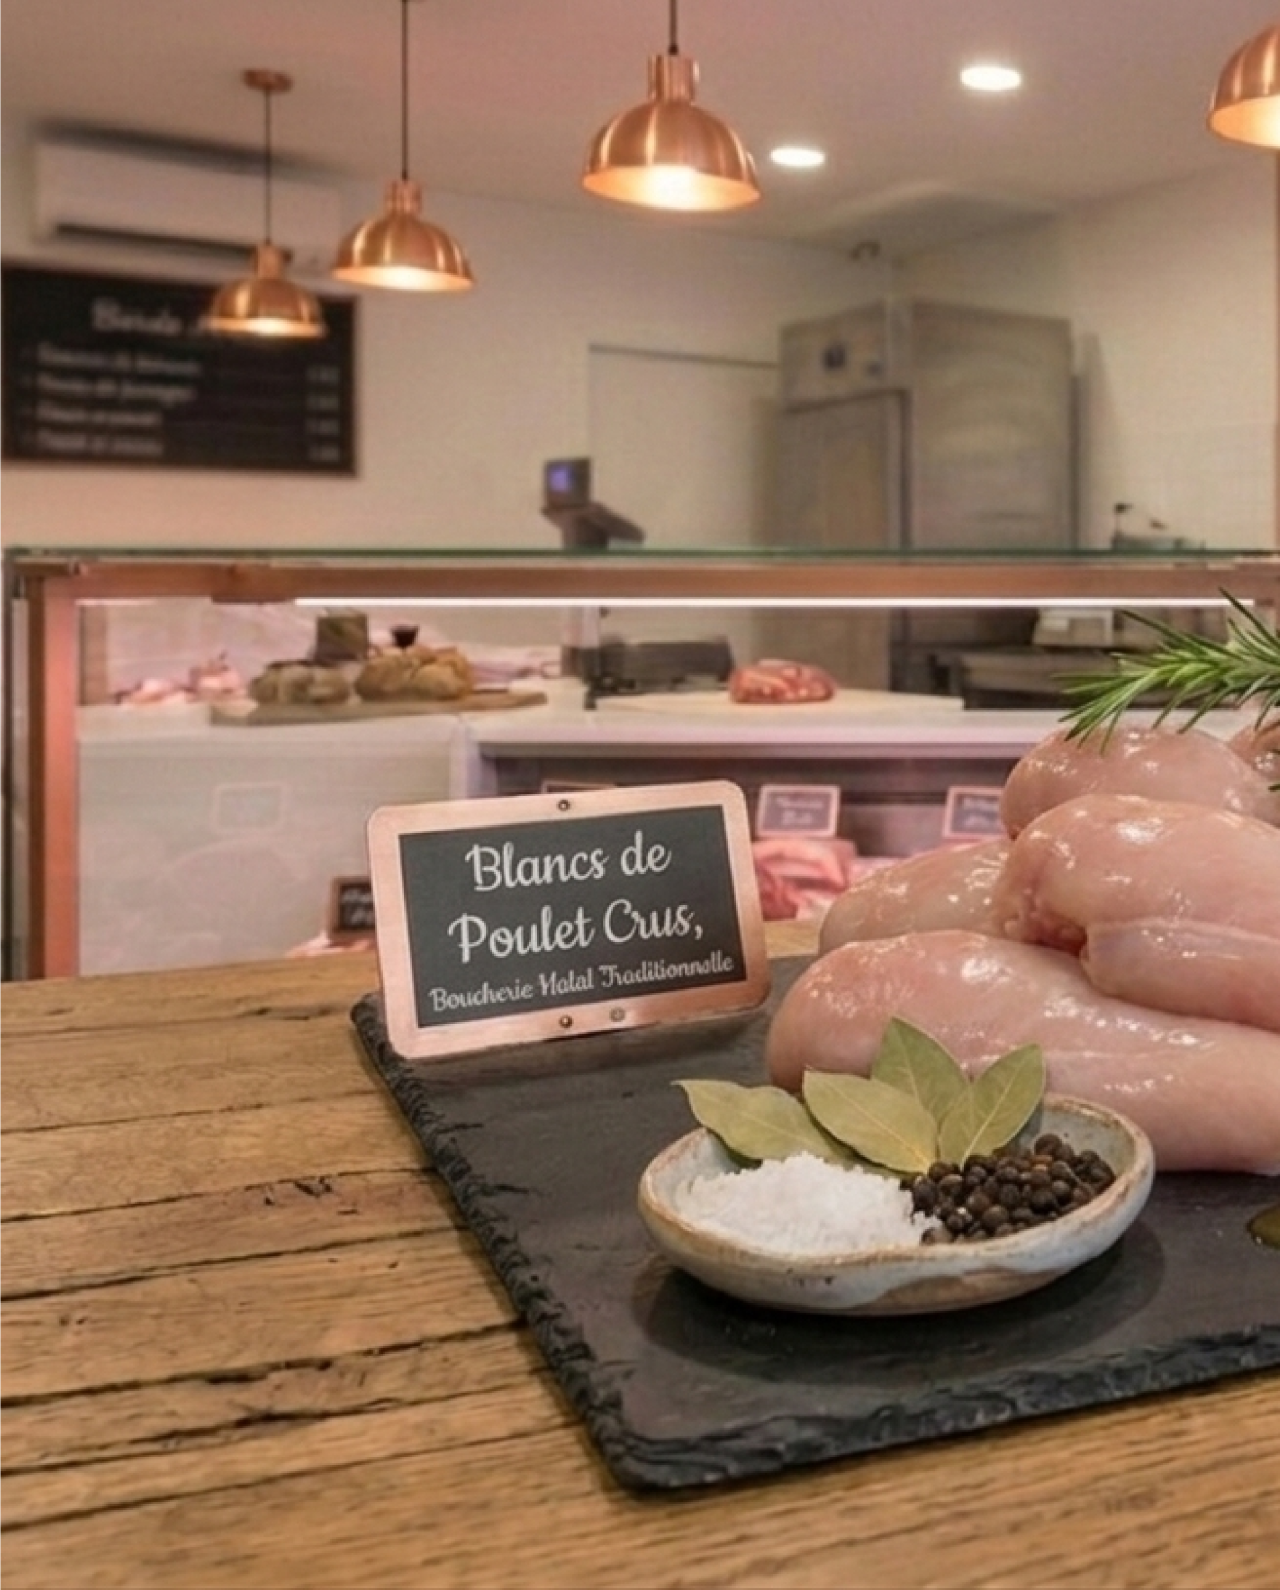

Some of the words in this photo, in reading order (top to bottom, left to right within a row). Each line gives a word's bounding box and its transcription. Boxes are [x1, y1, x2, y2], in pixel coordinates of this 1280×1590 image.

[464, 840, 609, 892] Blancs
[619, 829, 673, 876] de
[446, 904, 596, 964] Poulet
[603, 898, 704, 944] Crus,
[428, 979, 534, 1013] Boucherie
